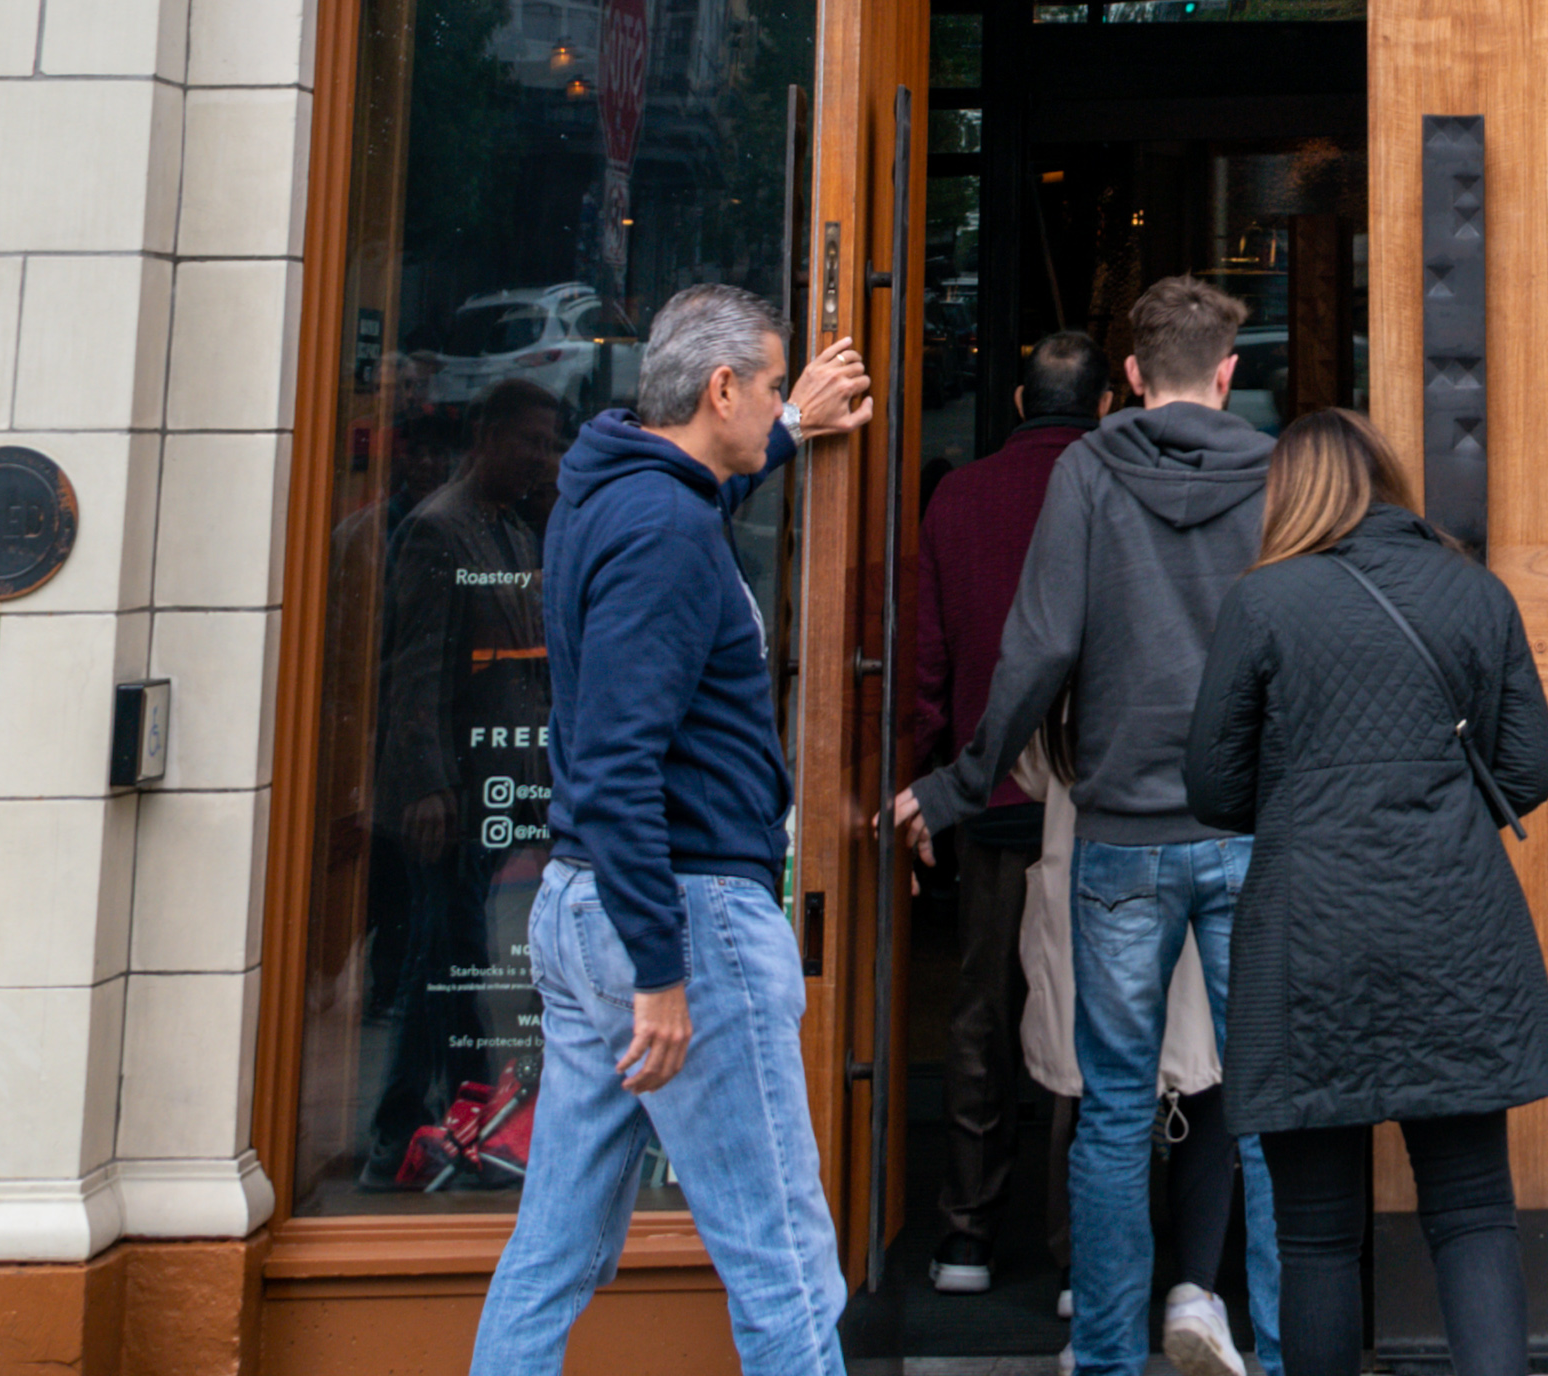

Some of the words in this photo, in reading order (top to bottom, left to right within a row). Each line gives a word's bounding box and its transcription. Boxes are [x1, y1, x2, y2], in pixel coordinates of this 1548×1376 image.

[455, 568, 533, 590] Roastery
[450, 964, 504, 977] Starbucks
[449, 1034, 474, 1047] Safe
[477, 1034, 532, 1050] protected
